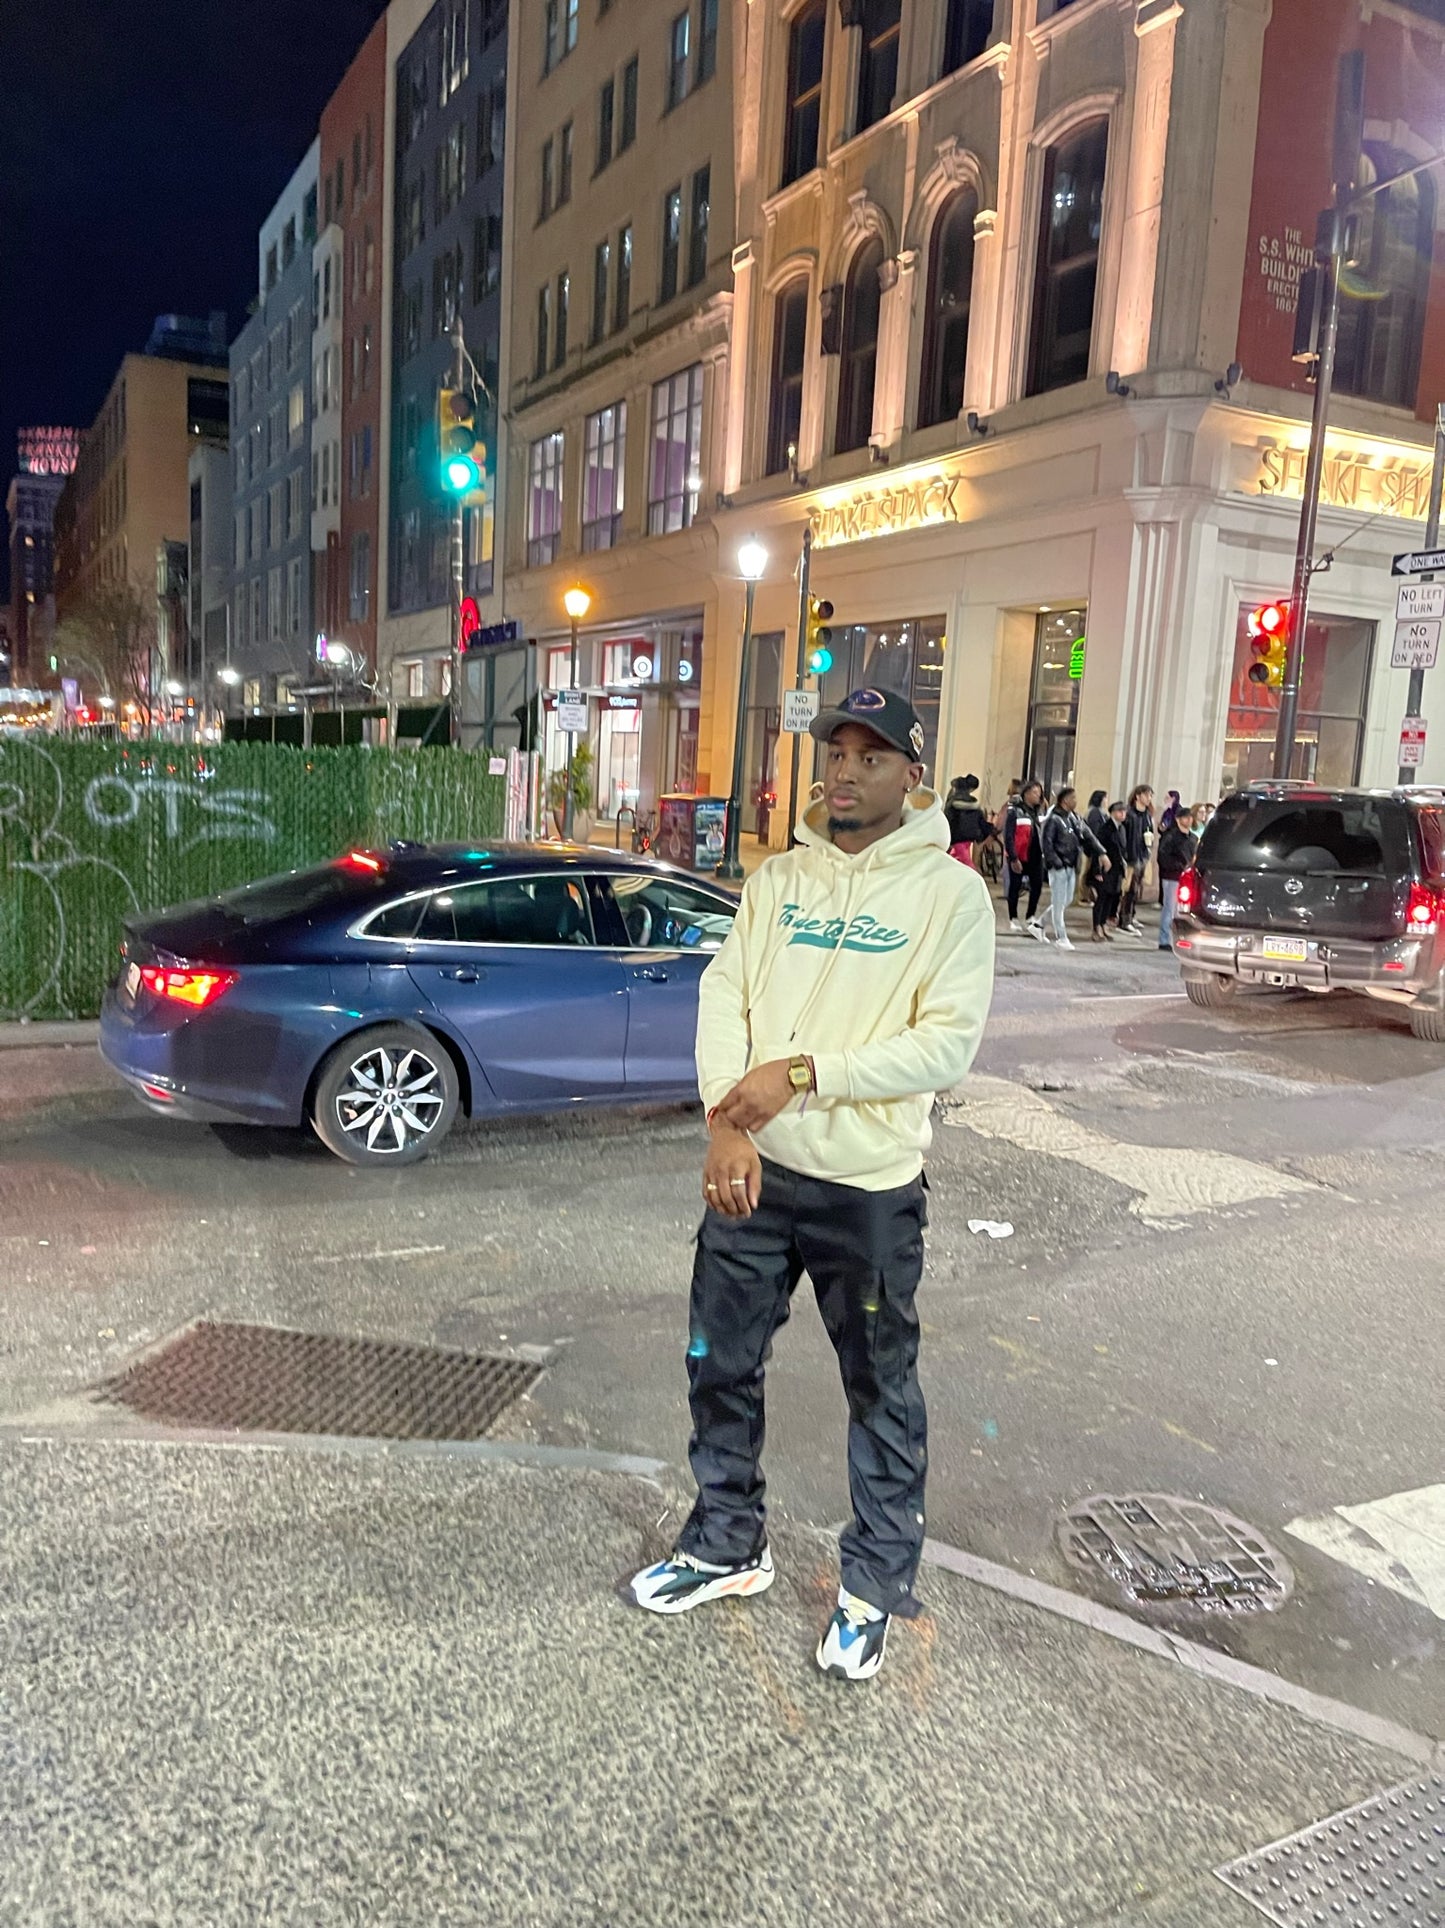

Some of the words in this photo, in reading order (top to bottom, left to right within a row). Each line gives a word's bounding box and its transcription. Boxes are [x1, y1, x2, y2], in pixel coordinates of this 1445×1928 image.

[1285, 226, 1301, 244] THE
[1260, 236, 1281, 258] S.S.
[1286, 242, 1321, 268] WHIT
[1261, 257, 1308, 283] BUILDI
[1267, 279, 1300, 299] ERECT
[1276, 296, 1298, 313] 1867
[810, 498, 876, 545] SHAKE
[878, 474, 959, 528] SHACK
[1410, 557, 1427, 569] ONE
[1432, 553, 1445, 564] WA
[1400, 590, 1416, 601] NO
[1421, 588, 1442, 600] LEFT
[1409, 604, 1432, 614] TURN
[1410, 624, 1427, 636] NO
[1403, 639, 1430, 650] TURN
[1395, 652, 1407, 664] ON
[1411, 651, 1432, 664] RED
[795, 695, 807, 704] NO
[790, 707, 812, 716] TURN
[786, 719, 797, 728] ON
[799, 719, 809, 728] RE
[823, 917, 846, 938] to
[845, 915, 906, 942] Size
